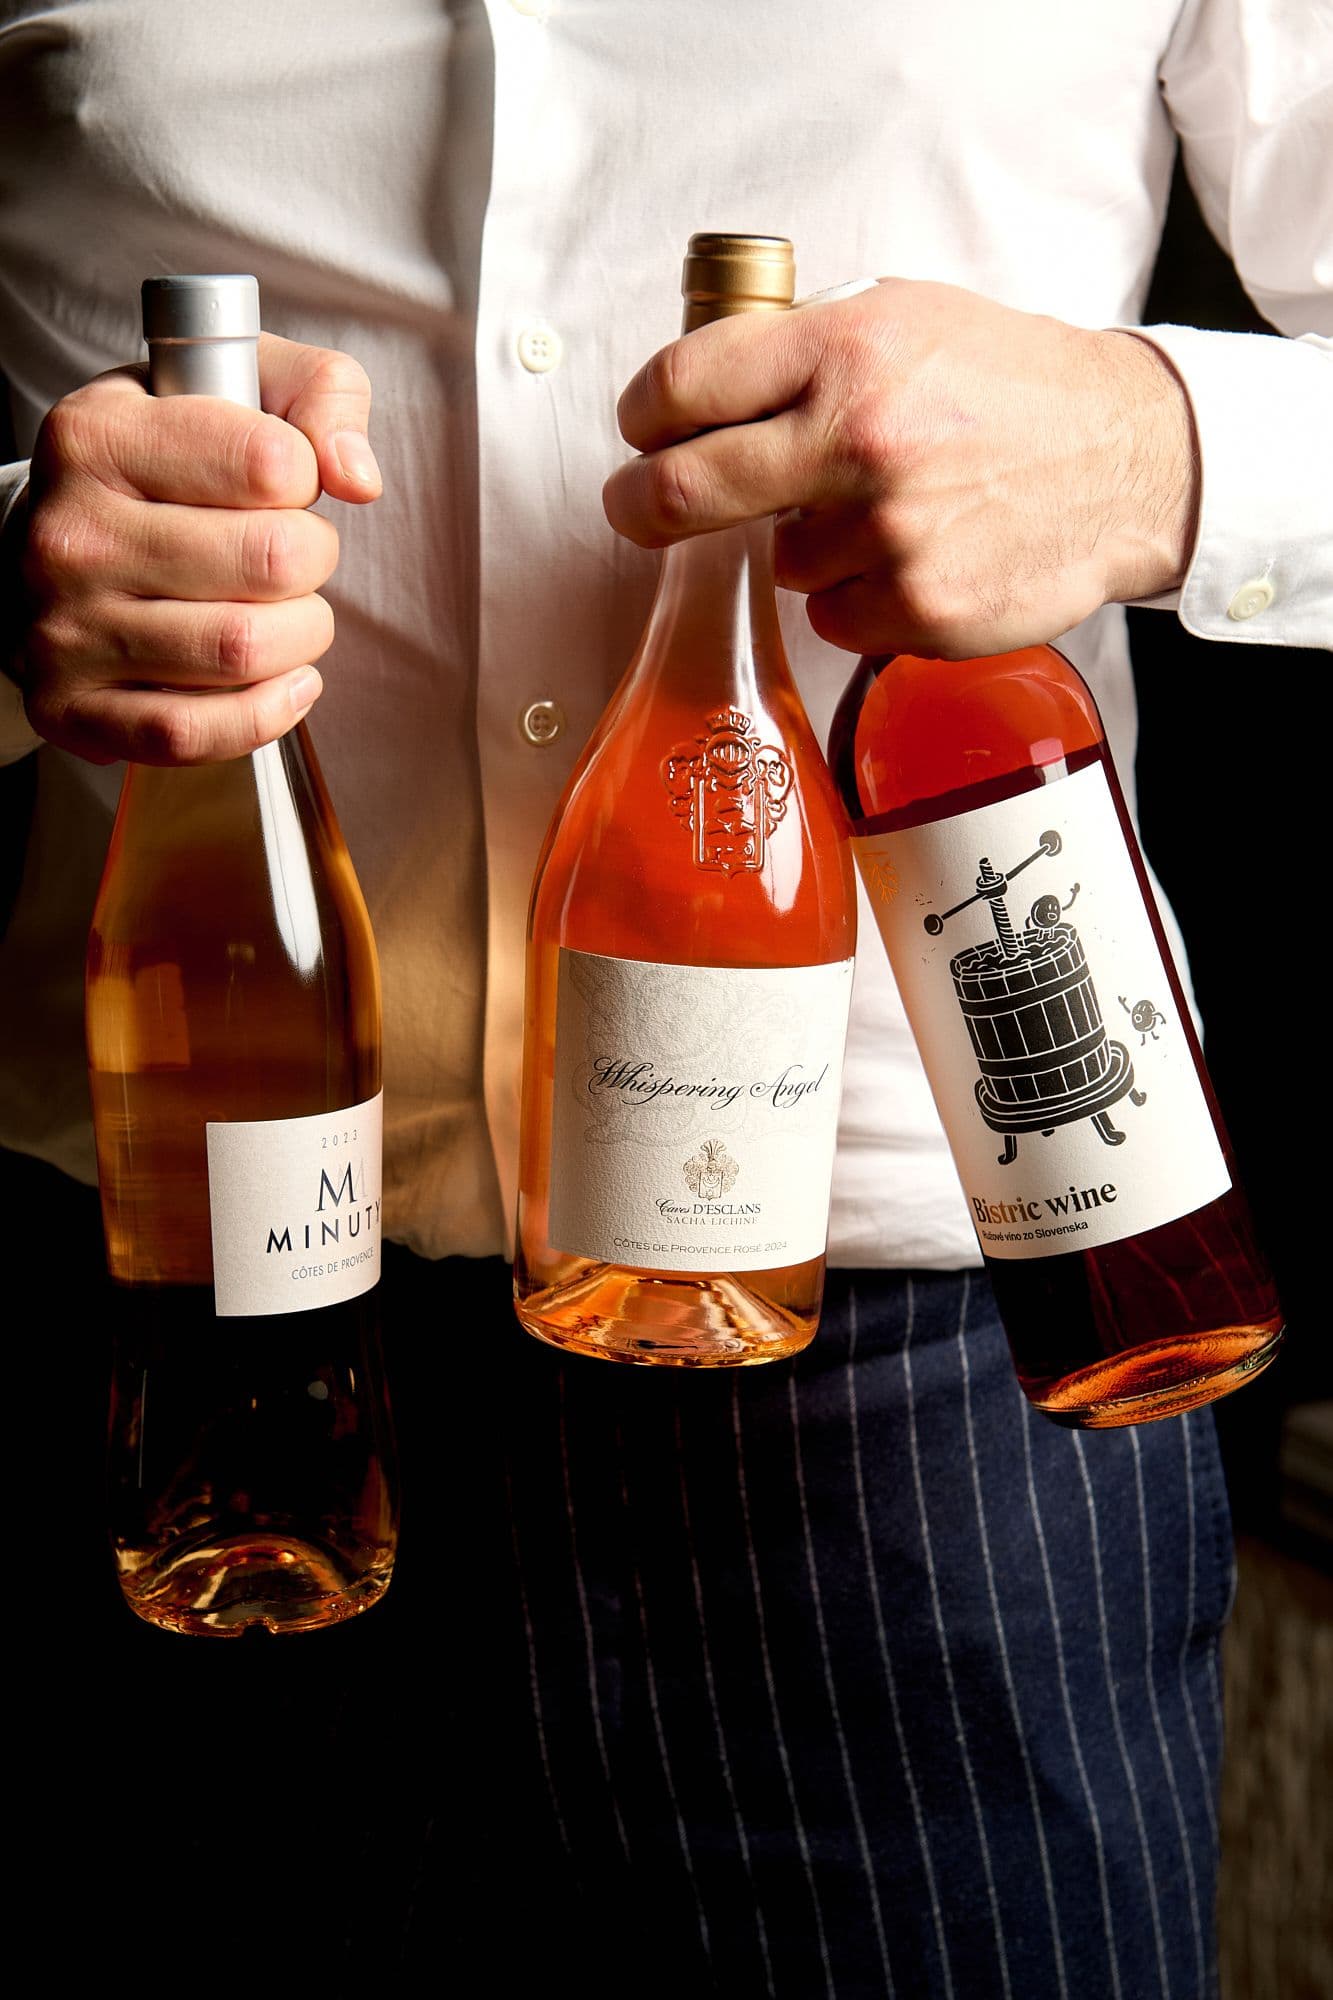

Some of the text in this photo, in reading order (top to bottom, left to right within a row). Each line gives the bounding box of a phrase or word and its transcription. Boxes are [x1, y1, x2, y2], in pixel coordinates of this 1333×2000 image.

[588, 1057, 829, 1111] Whispering Angel
[321, 1129, 358, 1149] 2023
[655, 1198, 761, 1217] Caves D'ESCLANS
[972, 1183, 1117, 1224] Bistric wine
[266, 1198, 380, 1253] MINUTY
[666, 1216, 706, 1225] SACHA
[1022, 1232, 1034, 1241] zo
[1034, 1220, 1089, 1239] Slovenska
[614, 1237, 650, 1251] CÔTES
[652, 1243, 670, 1253] DE
[291, 1246, 375, 1280] CÔTES DE PROVENCE
